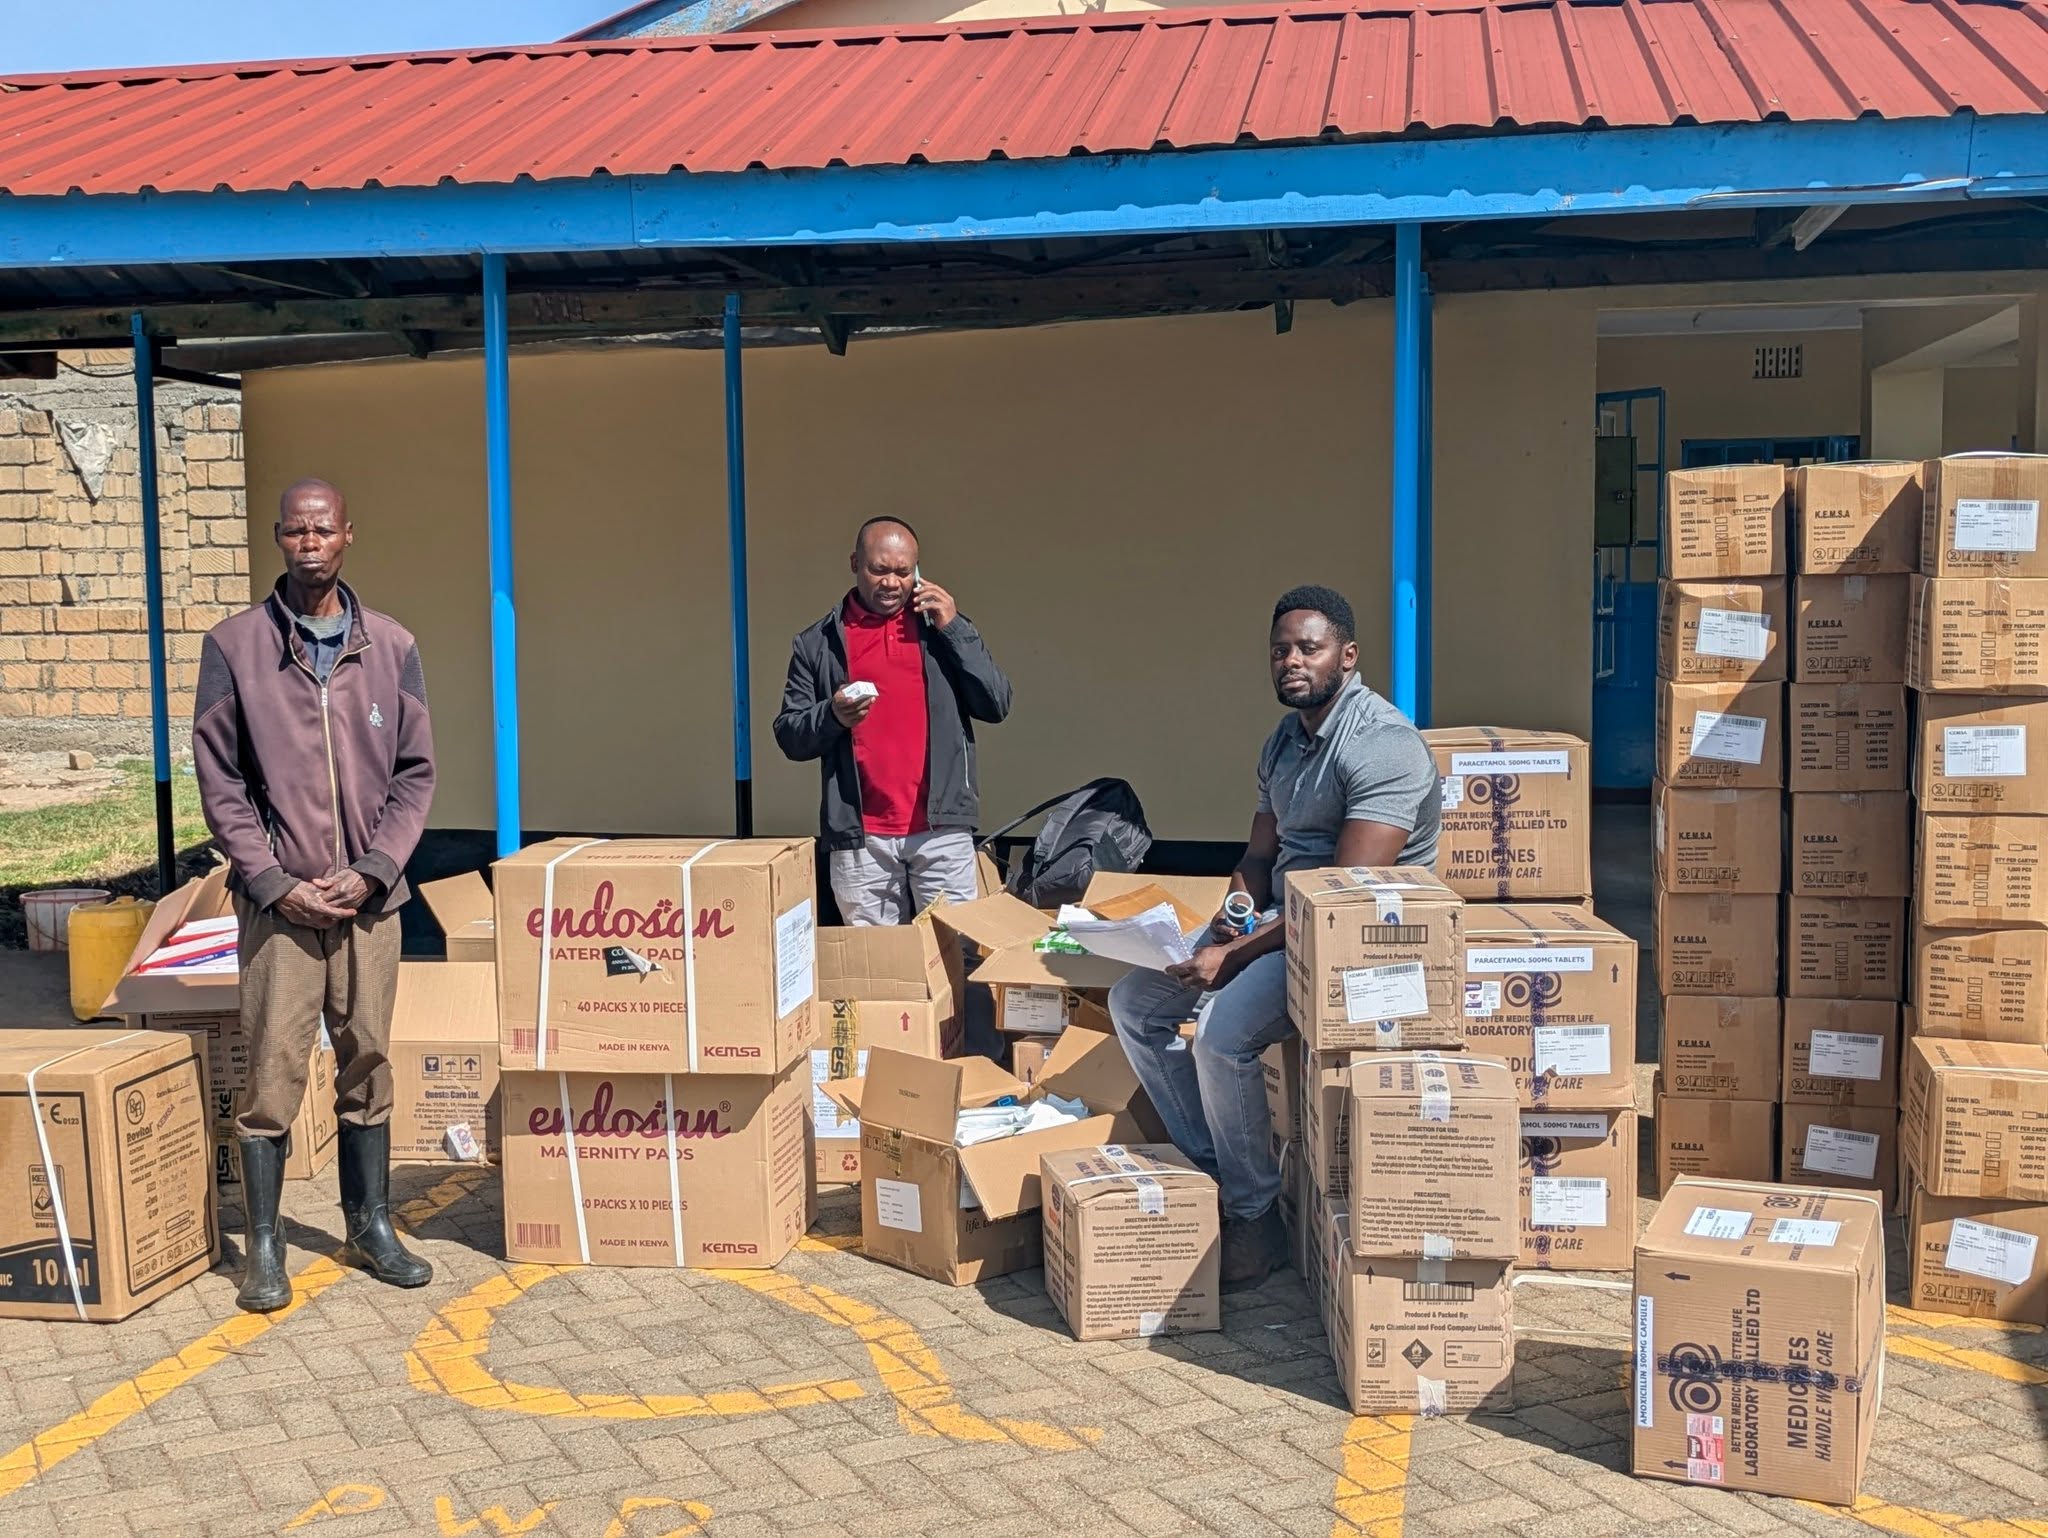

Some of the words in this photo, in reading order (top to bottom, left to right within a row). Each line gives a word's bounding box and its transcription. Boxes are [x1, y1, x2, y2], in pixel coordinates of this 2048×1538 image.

[1507, 810, 1534, 818] BETTER
[1535, 810, 1551, 818] LIFE
[1508, 820, 1545, 830] ALLIED
[1547, 819, 1568, 829] LTD
[1445, 868, 1485, 880] HANDLE
[1515, 867, 1543, 879] CARE
[526, 880, 735, 938] endosan
[577, 1001, 591, 1012] 40
[594, 1002, 627, 1013] PACKS
[630, 1002, 638, 1012] X
[639, 1002, 650, 1013] 10
[1546, 1014, 1576, 1022] BETTER
[1578, 1014, 1594, 1022] LIFE
[1465, 1025, 1532, 1036] ABORATORY
[599, 1043, 626, 1051] MADE
[1554, 1078, 1584, 1090] CARE
[425, 1090, 450, 1099] Questa
[450, 1091, 467, 1099] Care
[468, 1090, 480, 1099] Ltd.
[528, 1081, 731, 1139] endosan
[540, 1145, 640, 1160] MAERNITY
[593, 1199, 627, 1210] PACKS
[629, 1200, 637, 1210] X
[639, 1200, 649, 1210] 10
[652, 1200, 688, 1211] PIECS
[600, 1239, 626, 1247] MADE
[627, 1239, 637, 1247] IN
[639, 1239, 669, 1248] KENYA
[1554, 1237, 1584, 1250] CARE
[32, 1258, 59, 1287] 10
[1747, 1288, 1760, 1315] LTD
[1640, 1298, 1648, 1338] CAPSULES
[1733, 1308, 1743, 1328] LIFE
[1447, 1324, 1477, 1332] Company
[1732, 1330, 1742, 1360] ETTER
[1816, 1329, 1833, 1367] CARE
[1640, 1370, 1648, 1425] AMOXICILLIN
[1731, 1419, 1741, 1453] BETTER
[1745, 1385, 1759, 1476] LABORATORY
[1815, 1405, 1832, 1462] HANDLE
